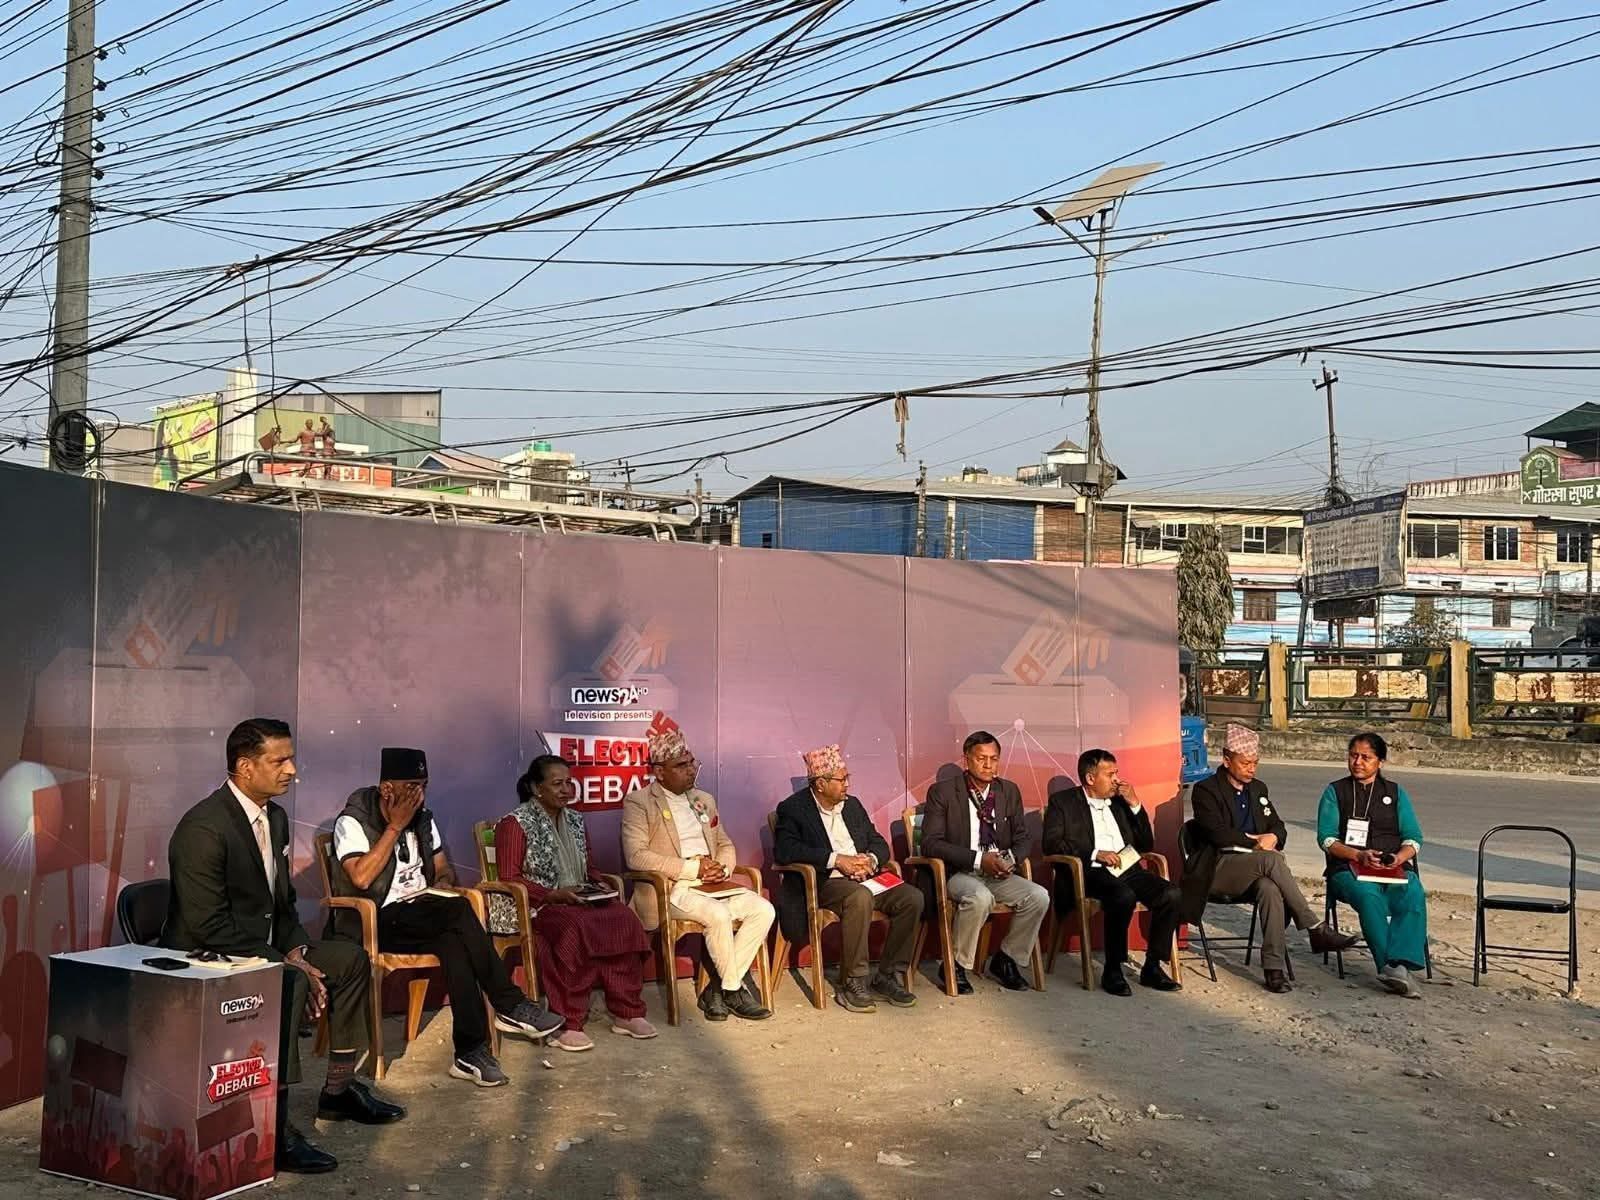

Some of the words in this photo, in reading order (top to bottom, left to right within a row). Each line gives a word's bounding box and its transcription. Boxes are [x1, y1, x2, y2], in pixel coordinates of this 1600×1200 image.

[1533, 485, 1567, 503] गोरखा
[1569, 485, 1594, 505] सुपर
[566, 711, 611, 721] Television
[614, 711, 653, 721] presents
[560, 738, 650, 765] ELECTI
[216, 1072, 262, 1097] DEBATE
